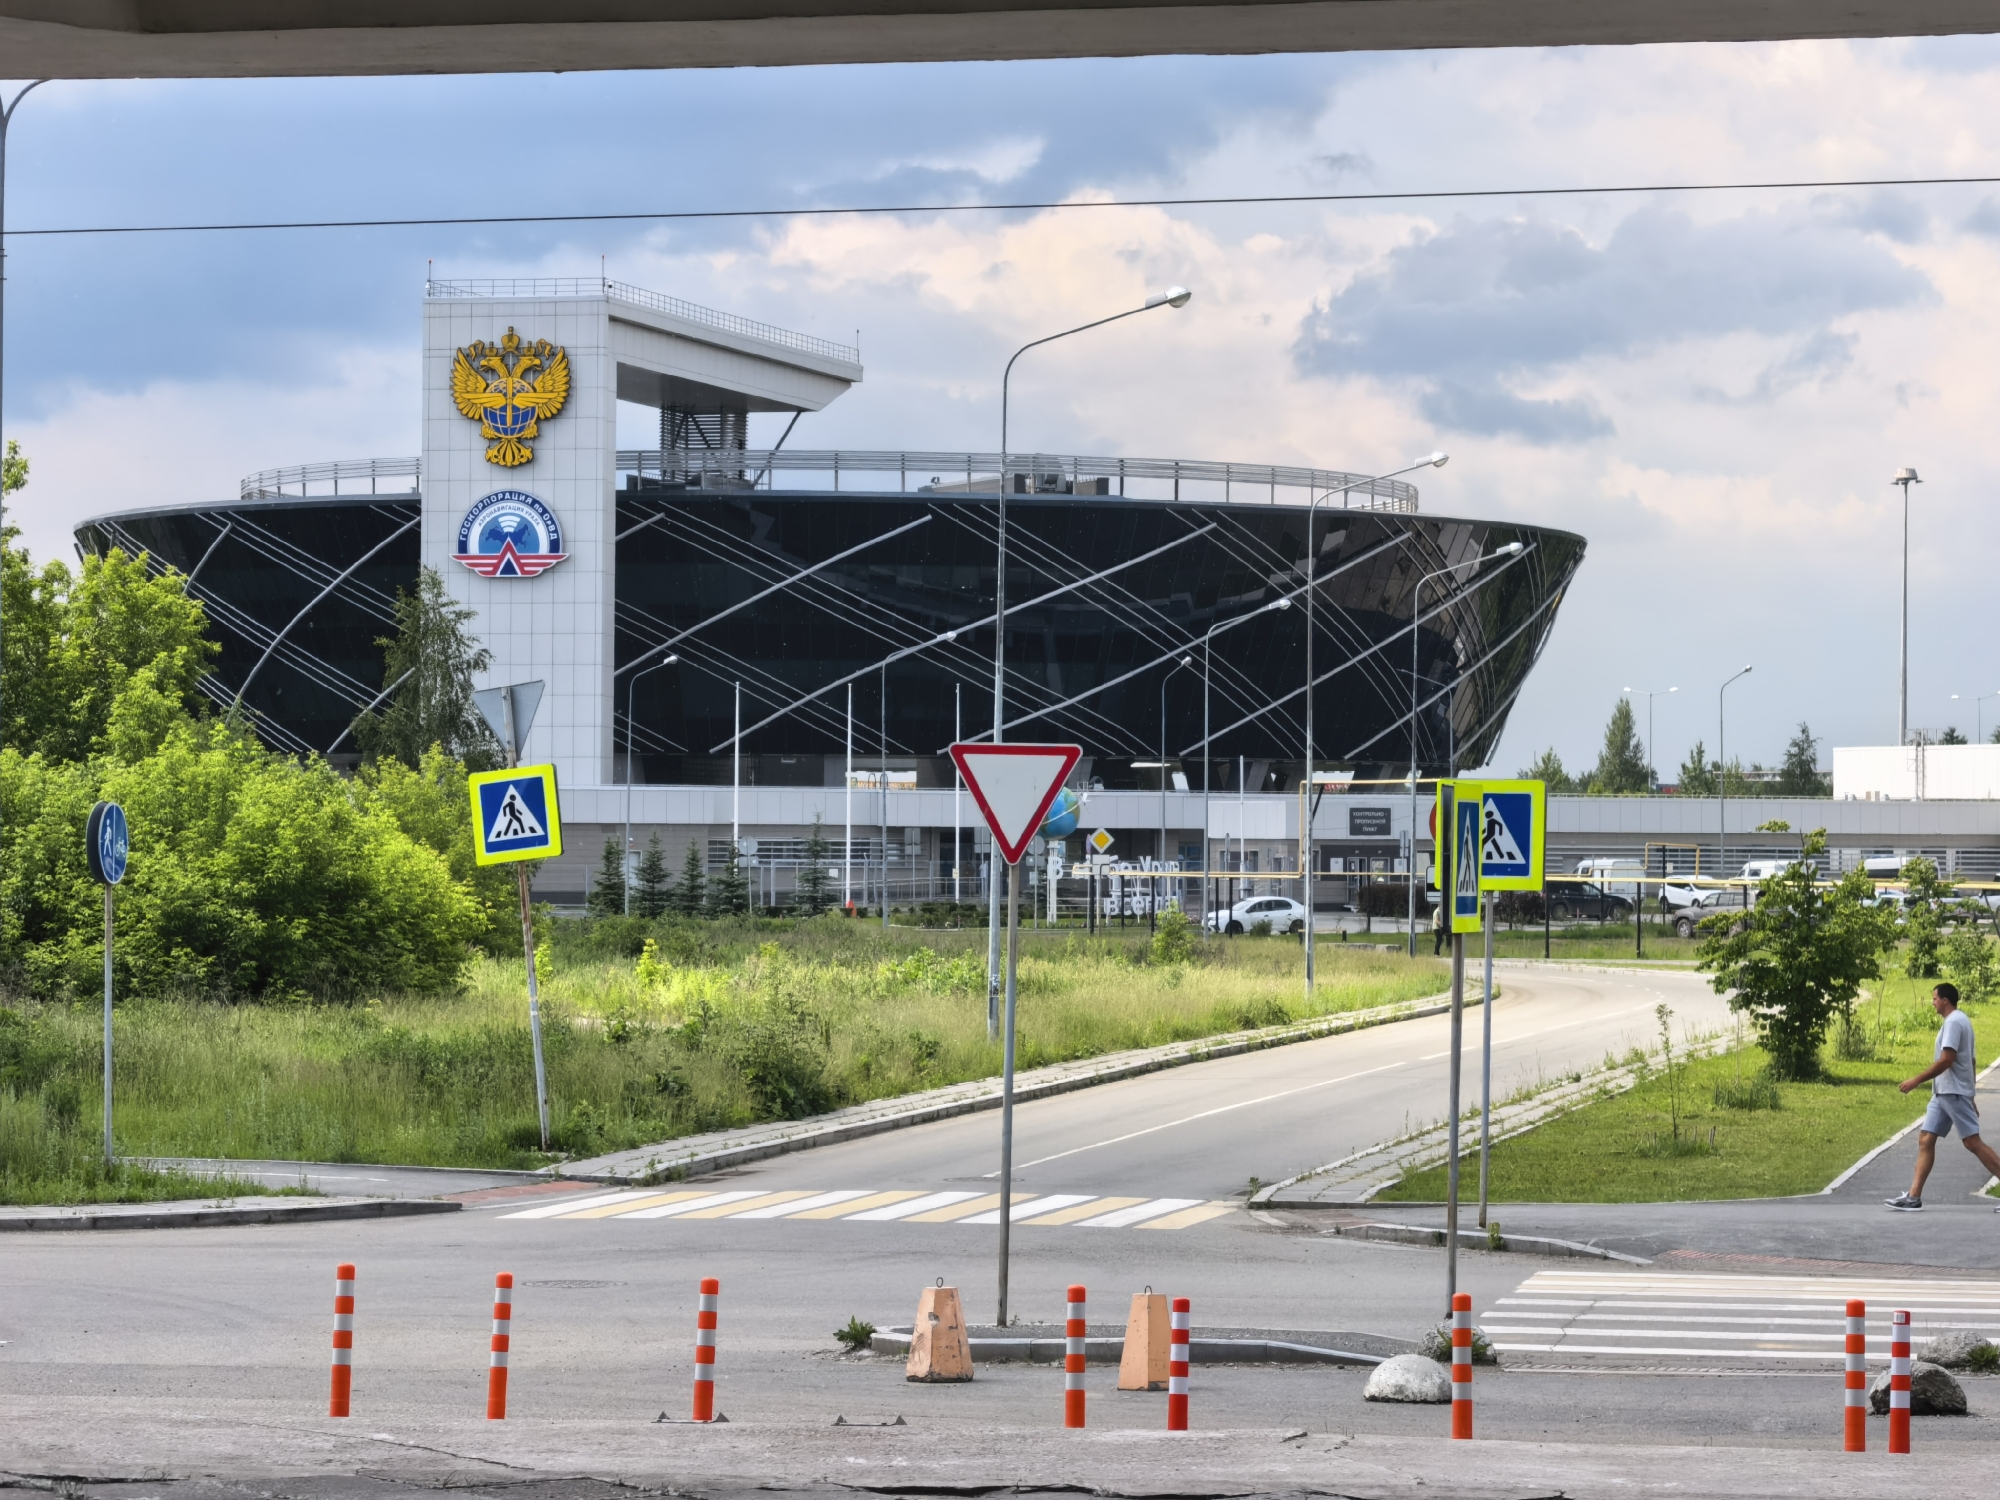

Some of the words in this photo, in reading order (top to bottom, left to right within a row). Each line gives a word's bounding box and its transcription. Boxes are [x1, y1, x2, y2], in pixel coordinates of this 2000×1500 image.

[460, 492, 533, 541] ГОСКОРПОРАЦИЯ
[542, 513, 558, 540] ОрВД
[478, 504, 525, 527] АЭРОНАВИГАЦИЯ
[524, 510, 541, 527] УРАЛА
